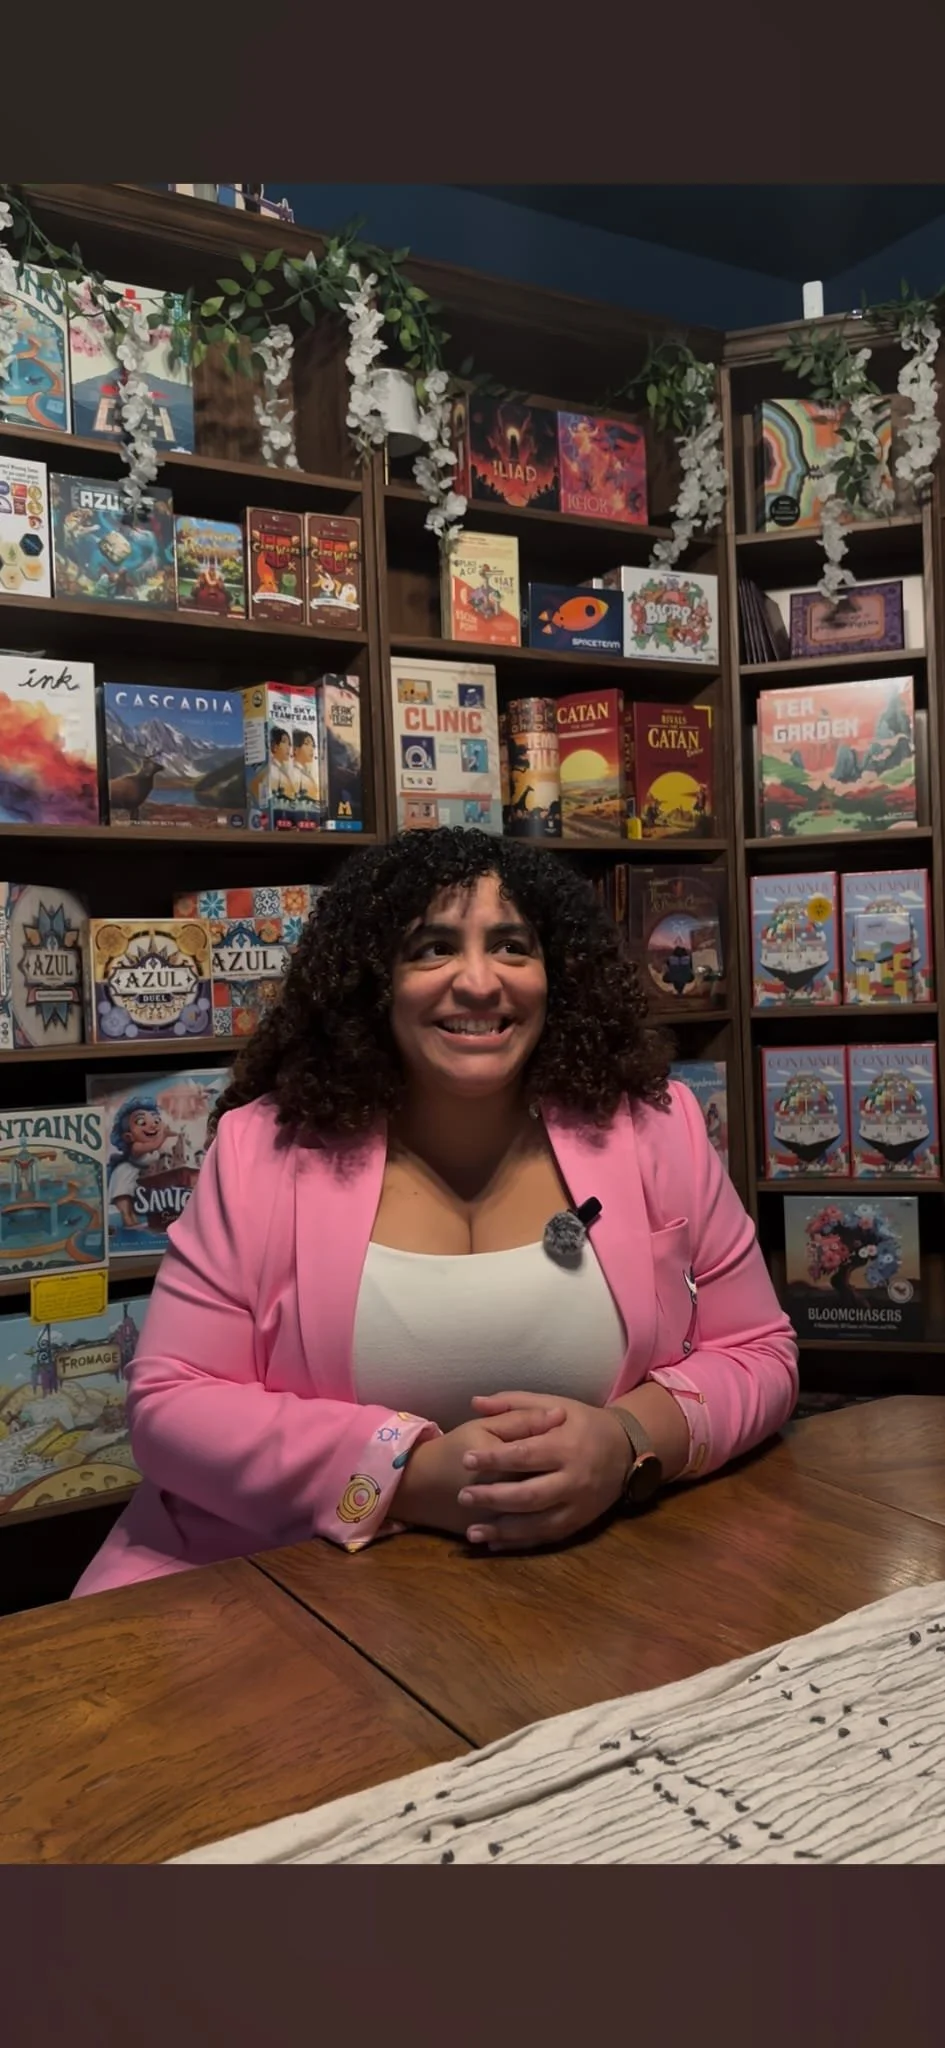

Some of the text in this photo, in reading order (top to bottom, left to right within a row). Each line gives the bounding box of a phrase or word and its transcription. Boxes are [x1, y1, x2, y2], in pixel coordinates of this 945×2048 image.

[492, 460, 537, 482] ILIAD
[80, 490, 120, 511] AZU
[572, 637, 621, 649] SPACETEAM
[18, 666, 80, 691] ink
[115, 691, 233, 714] CASCADIA
[272, 703, 288, 713] SKY
[293, 706, 311, 715] SKY
[772, 697, 815, 720] TEA
[404, 706, 483, 734] CLINIC
[557, 702, 610, 725] CATAN
[661, 714, 687, 725] RIVALS
[647, 727, 700, 749] CATAN
[773, 717, 859, 743] GARDEN
[756, 882, 830, 895] CONTAINER
[846, 879, 920, 894] CONTAINER
[33, 954, 73, 976] AZUL
[212, 949, 276, 973] AZUL
[125, 971, 182, 988] AZUL
[143, 994, 167, 1002] DUEL
[768, 1054, 840, 1069] CONTAINER
[853, 1053, 928, 1067] CONTAINER
[808, 1306, 902, 1322] BLOOMCHASERS
[59, 1351, 118, 1374] FROMAGE
